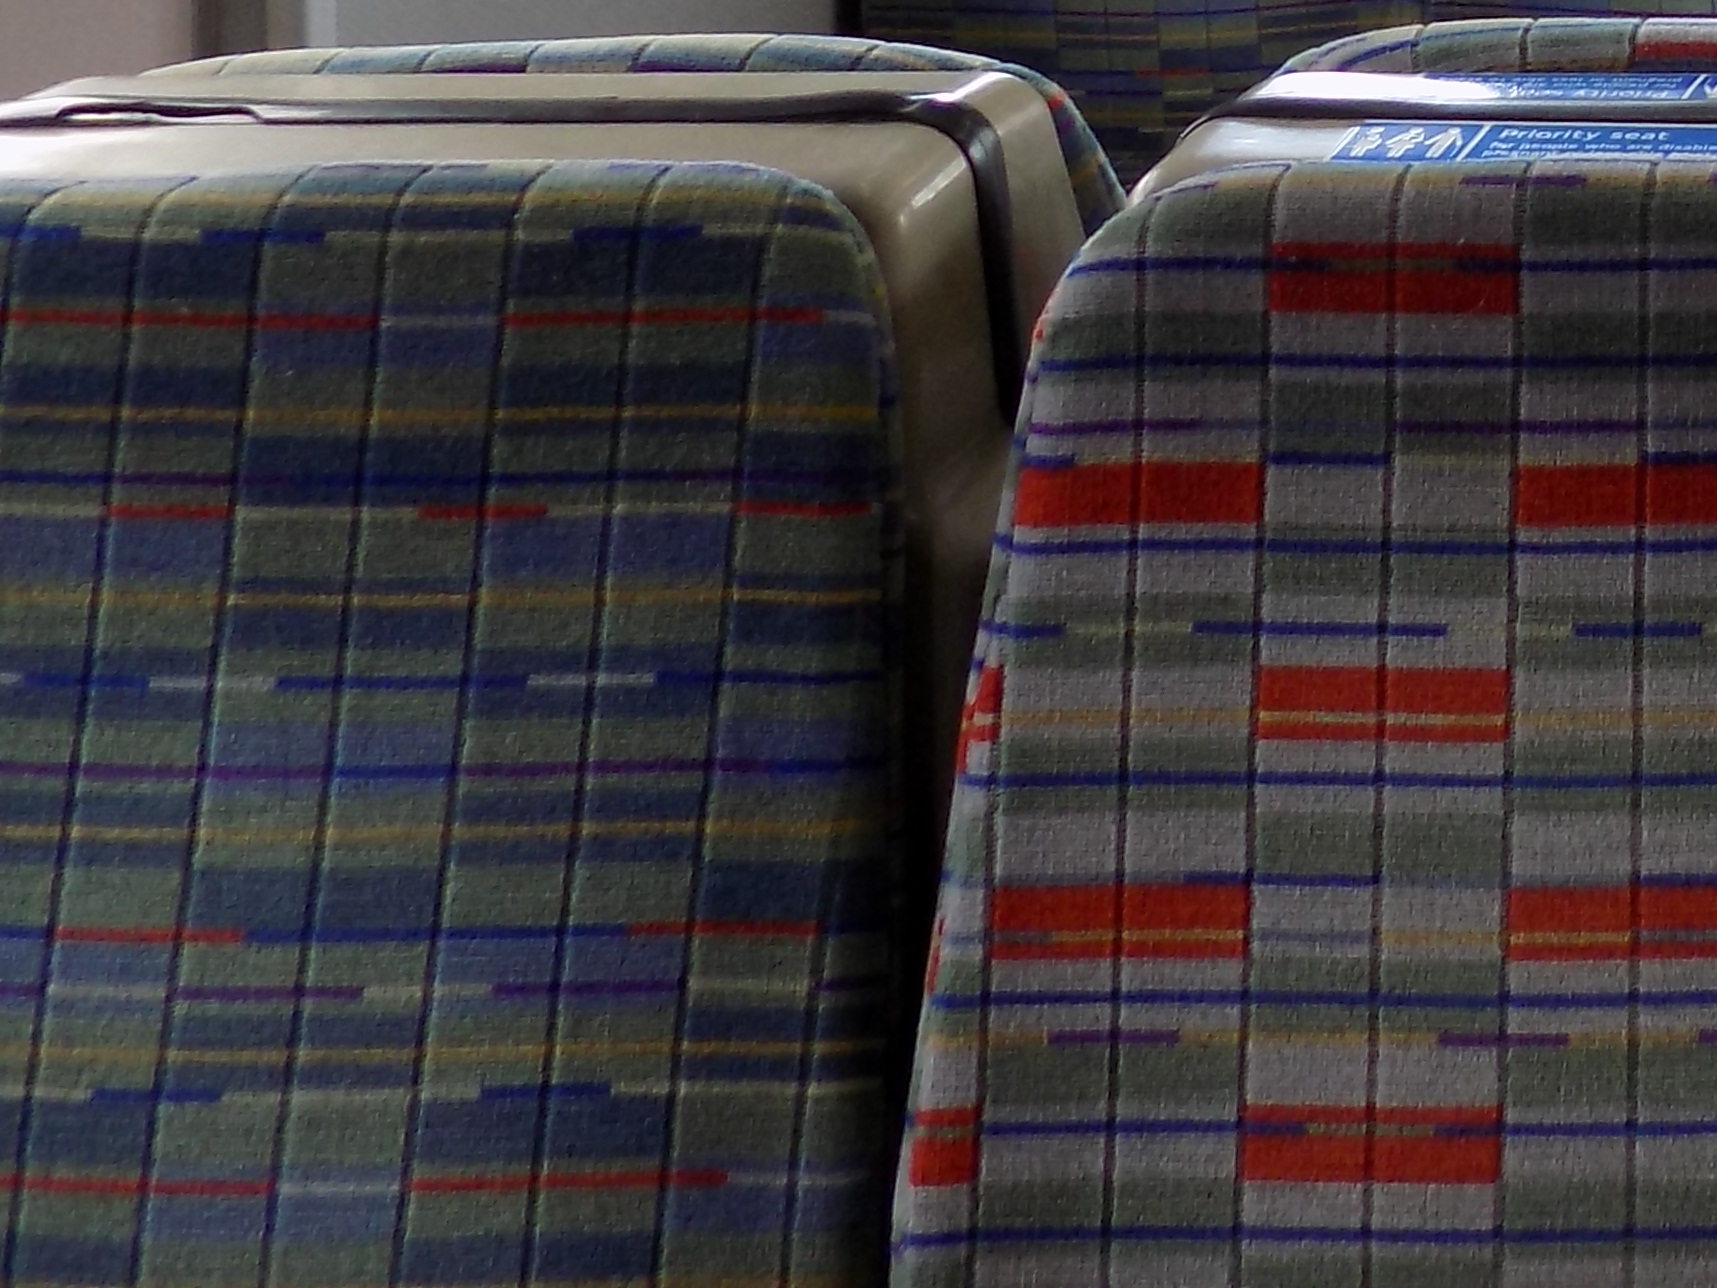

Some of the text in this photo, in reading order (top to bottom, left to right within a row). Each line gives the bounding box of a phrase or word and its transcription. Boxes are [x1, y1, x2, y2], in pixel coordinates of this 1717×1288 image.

[1499, 126, 1670, 142] Priority seat
[1488, 140, 1516, 150] for
[1518, 141, 1580, 152] people
[1584, 141, 1621, 151] who
[1625, 142, 1653, 151] are
